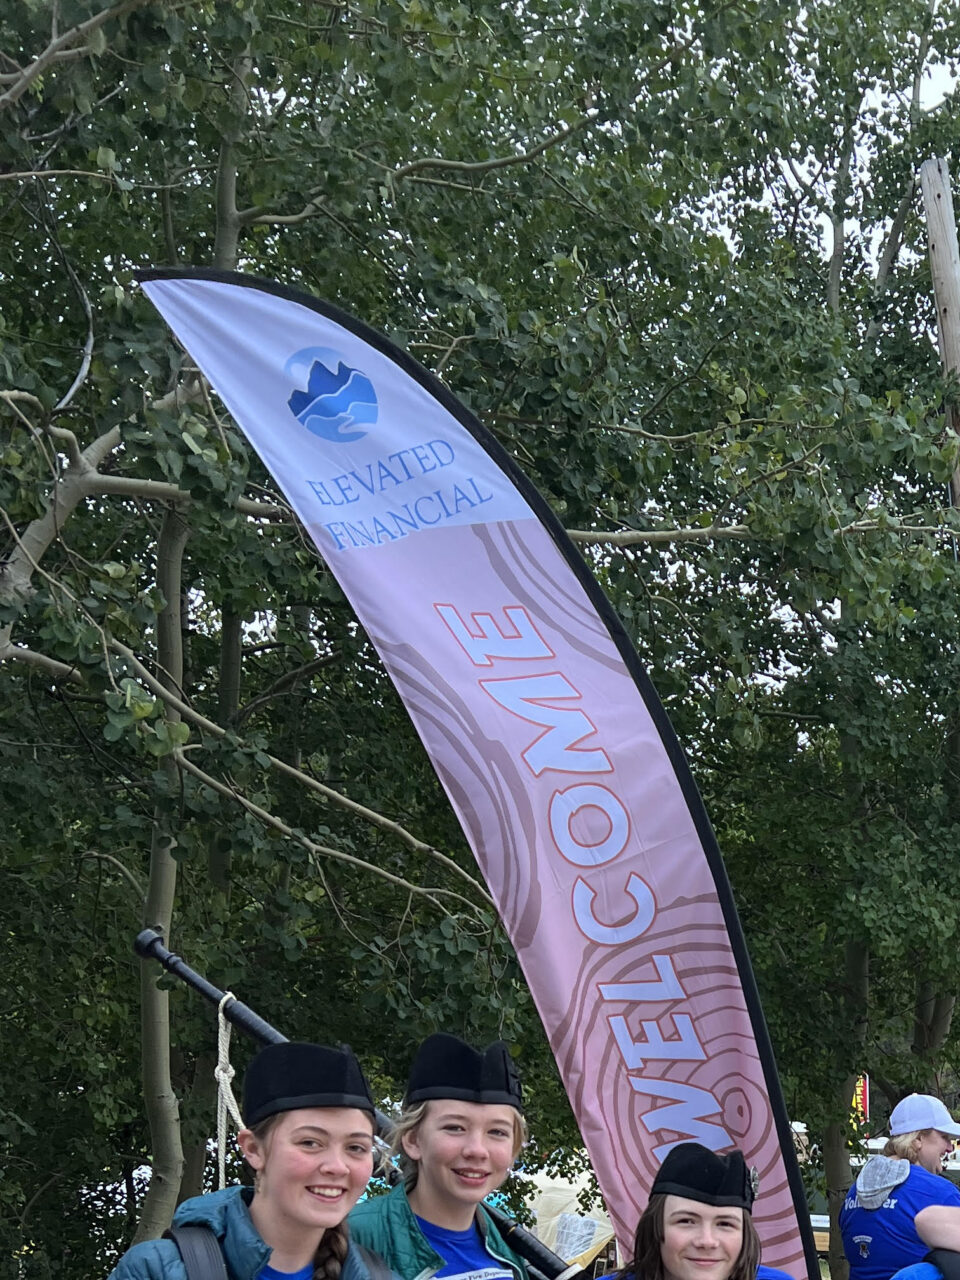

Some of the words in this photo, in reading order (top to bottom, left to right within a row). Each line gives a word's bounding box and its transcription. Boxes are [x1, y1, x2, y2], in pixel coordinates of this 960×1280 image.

[307, 439, 455, 506] ELEVATED
[324, 477, 493, 550] FINANCIAL
[433, 603, 736, 1163] WELCOME
